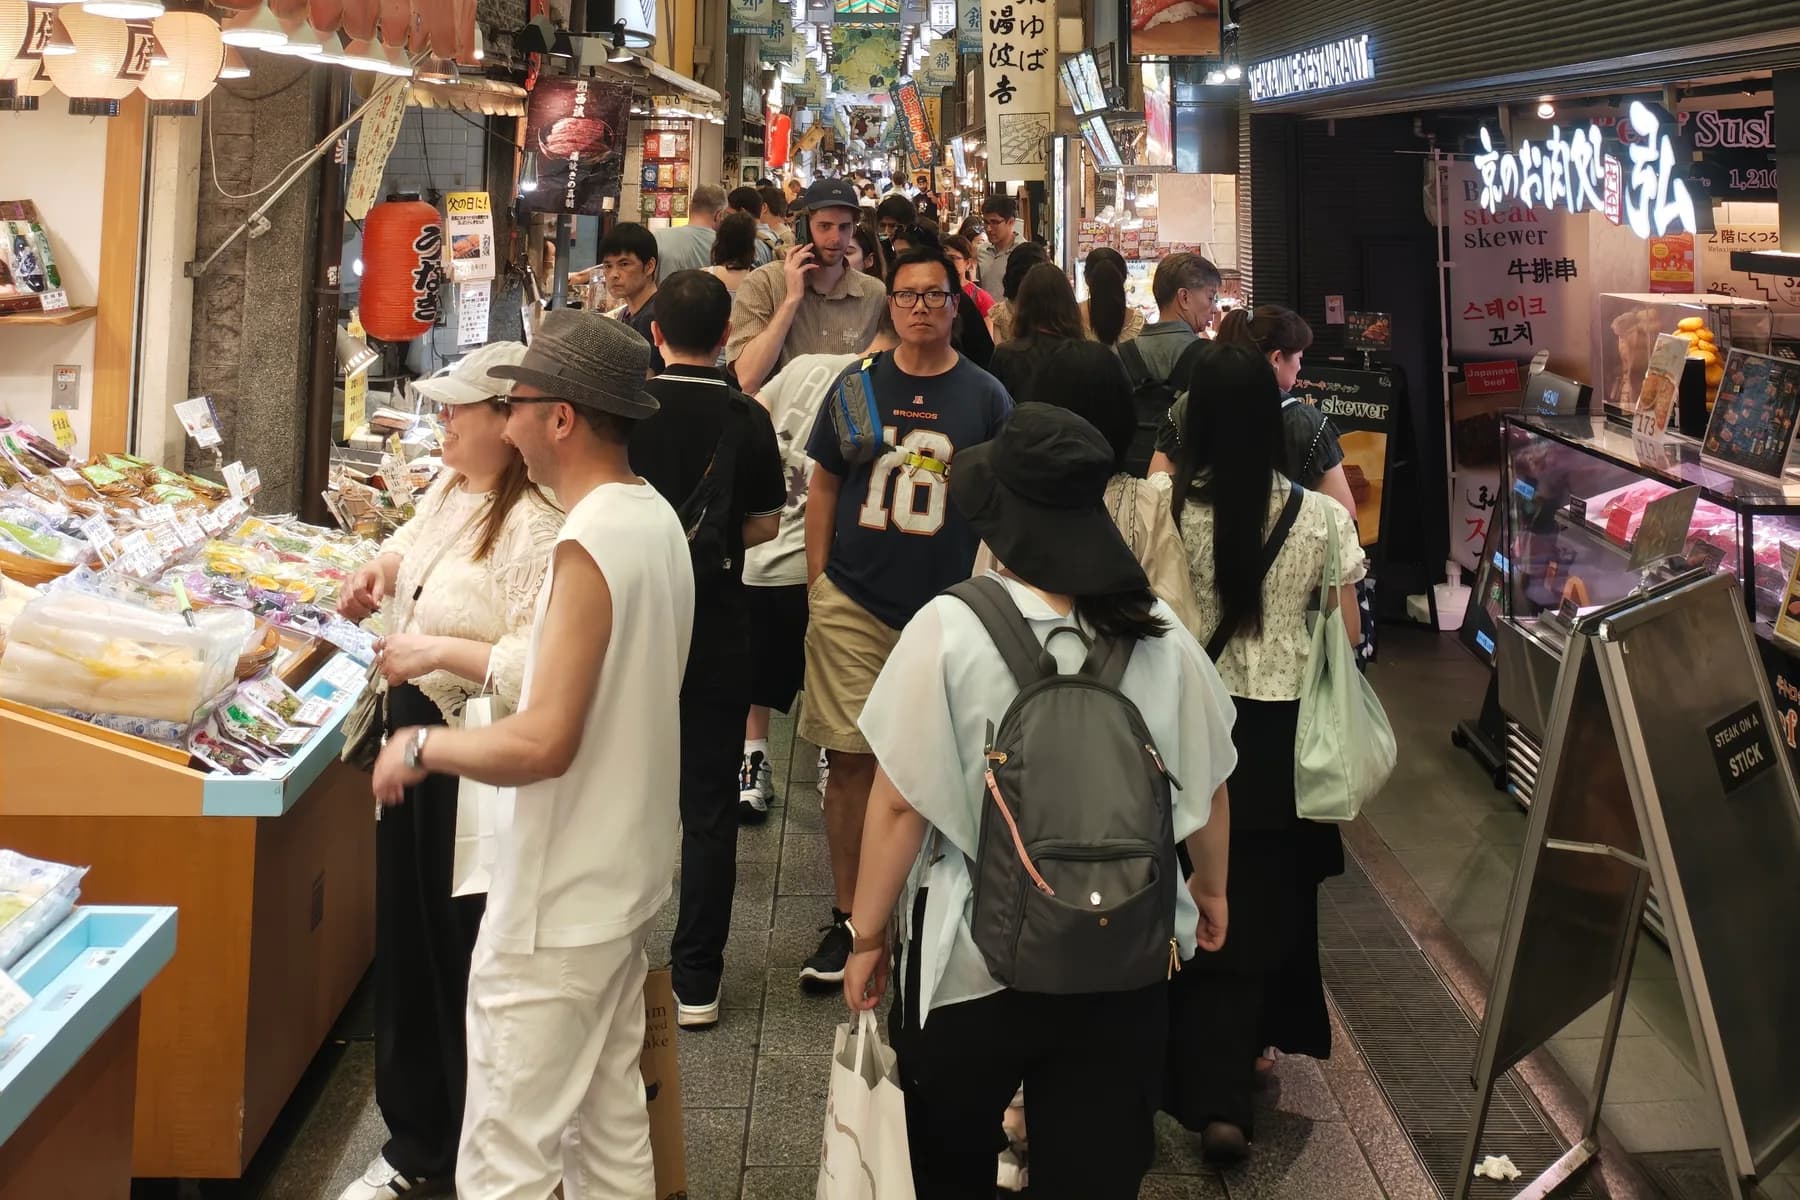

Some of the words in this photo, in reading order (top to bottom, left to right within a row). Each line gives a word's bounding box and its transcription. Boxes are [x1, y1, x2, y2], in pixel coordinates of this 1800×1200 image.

[1475, 126, 1606, 214] 京のお肉処
[1625, 101, 1696, 239] 弘
[1464, 229, 1548, 248] skewer
[1508, 257, 1577, 284] 牛排串
[1463, 296, 1547, 320] 스테이크
[1489, 321, 1533, 346] 꼬치
[1467, 367, 1516, 377] Japanese
[893, 409, 938, 420] BRONCOS
[1321, 395, 1389, 419] skewer
[1714, 725, 1739, 748] STEAK
[1739, 719, 1751, 733] ON
[1751, 713, 1759, 726] A
[1728, 742, 1764, 778] STICK
